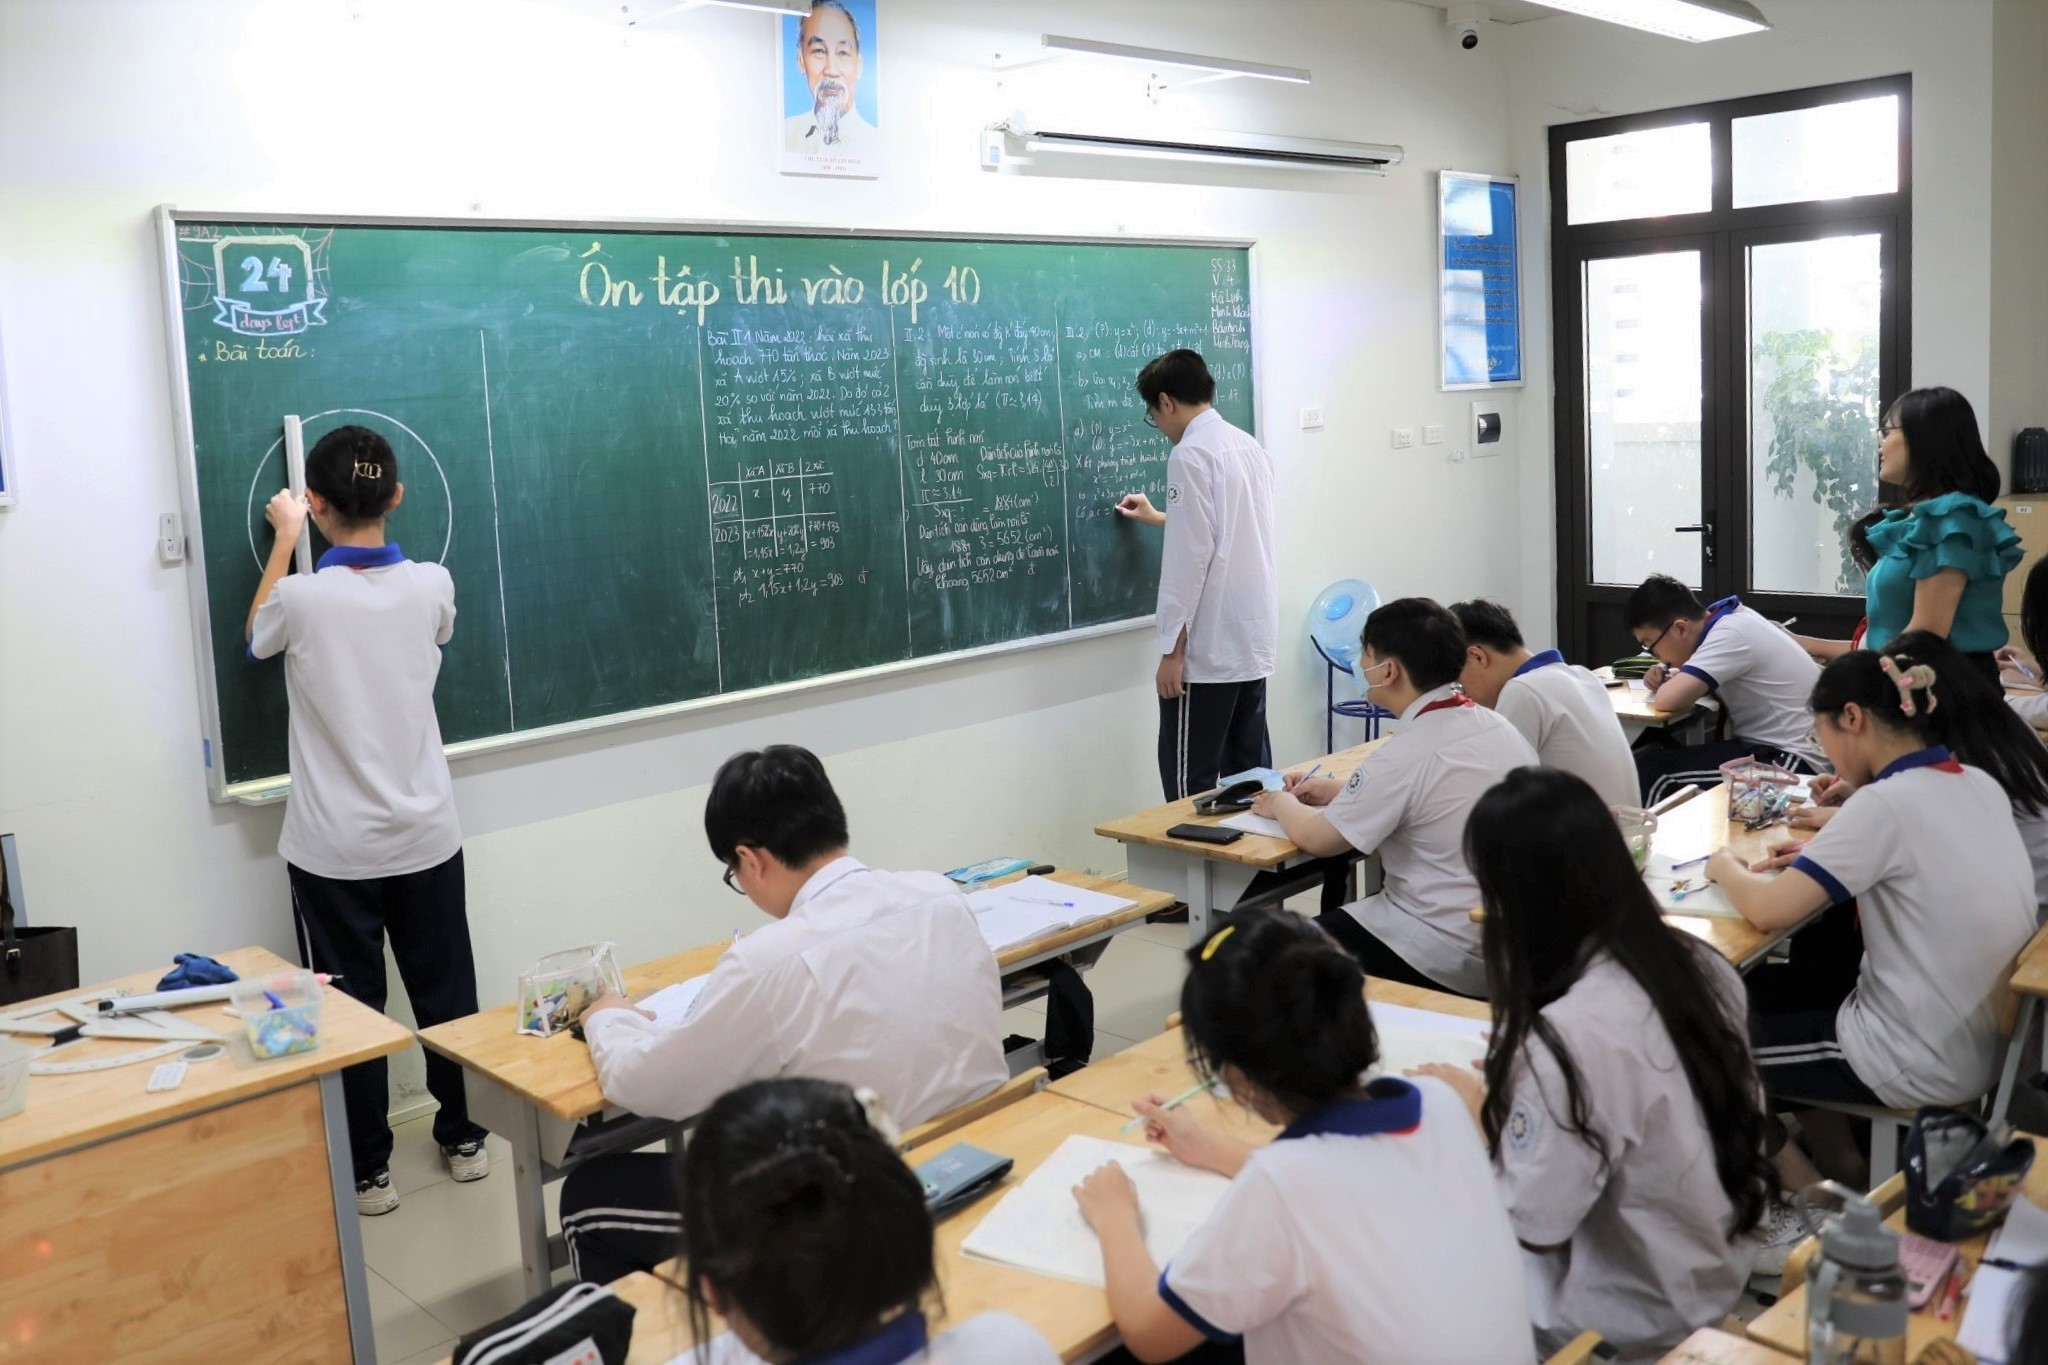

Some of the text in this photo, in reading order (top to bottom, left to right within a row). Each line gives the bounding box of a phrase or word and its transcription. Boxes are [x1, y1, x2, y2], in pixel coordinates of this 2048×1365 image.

[240, 256, 293, 293] 24
[579, 241, 980, 326] Ôn tập thi vào lớp 10
[240, 313, 272, 331] days
[707, 330, 728, 346] Bài
[755, 330, 783, 344] Năm
[838, 328, 853, 341] xã
[855, 325, 873, 343] thu
[216, 340, 249, 361] Bài
[758, 349, 779, 364] 770
[837, 348, 860, 360] Năm
[863, 348, 890, 361] 2023
[714, 372, 727, 387] xã
[734, 368, 746, 383] A
[809, 372, 822, 383] xã
[828, 366, 836, 380] B
[715, 392, 741, 409] 20%
[746, 395, 758, 405] so
[779, 388, 804, 402] năm
[840, 386, 853, 400] Do
[855, 383, 869, 399] đó
[882, 385, 890, 397] 2
[739, 407, 763, 425] thu
[863, 403, 883, 416] 133
[742, 429, 767, 443] năm
[769, 428, 800, 441] 2022
[841, 419, 860, 436] thu
[805, 462, 813, 473] 2
[711, 482, 831, 514] 2022 x y 770
[714, 527, 740, 544] 2023
[819, 537, 836, 550] 903
[996, 531, 1024, 545] 5652
[971, 569, 996, 584] 5652
